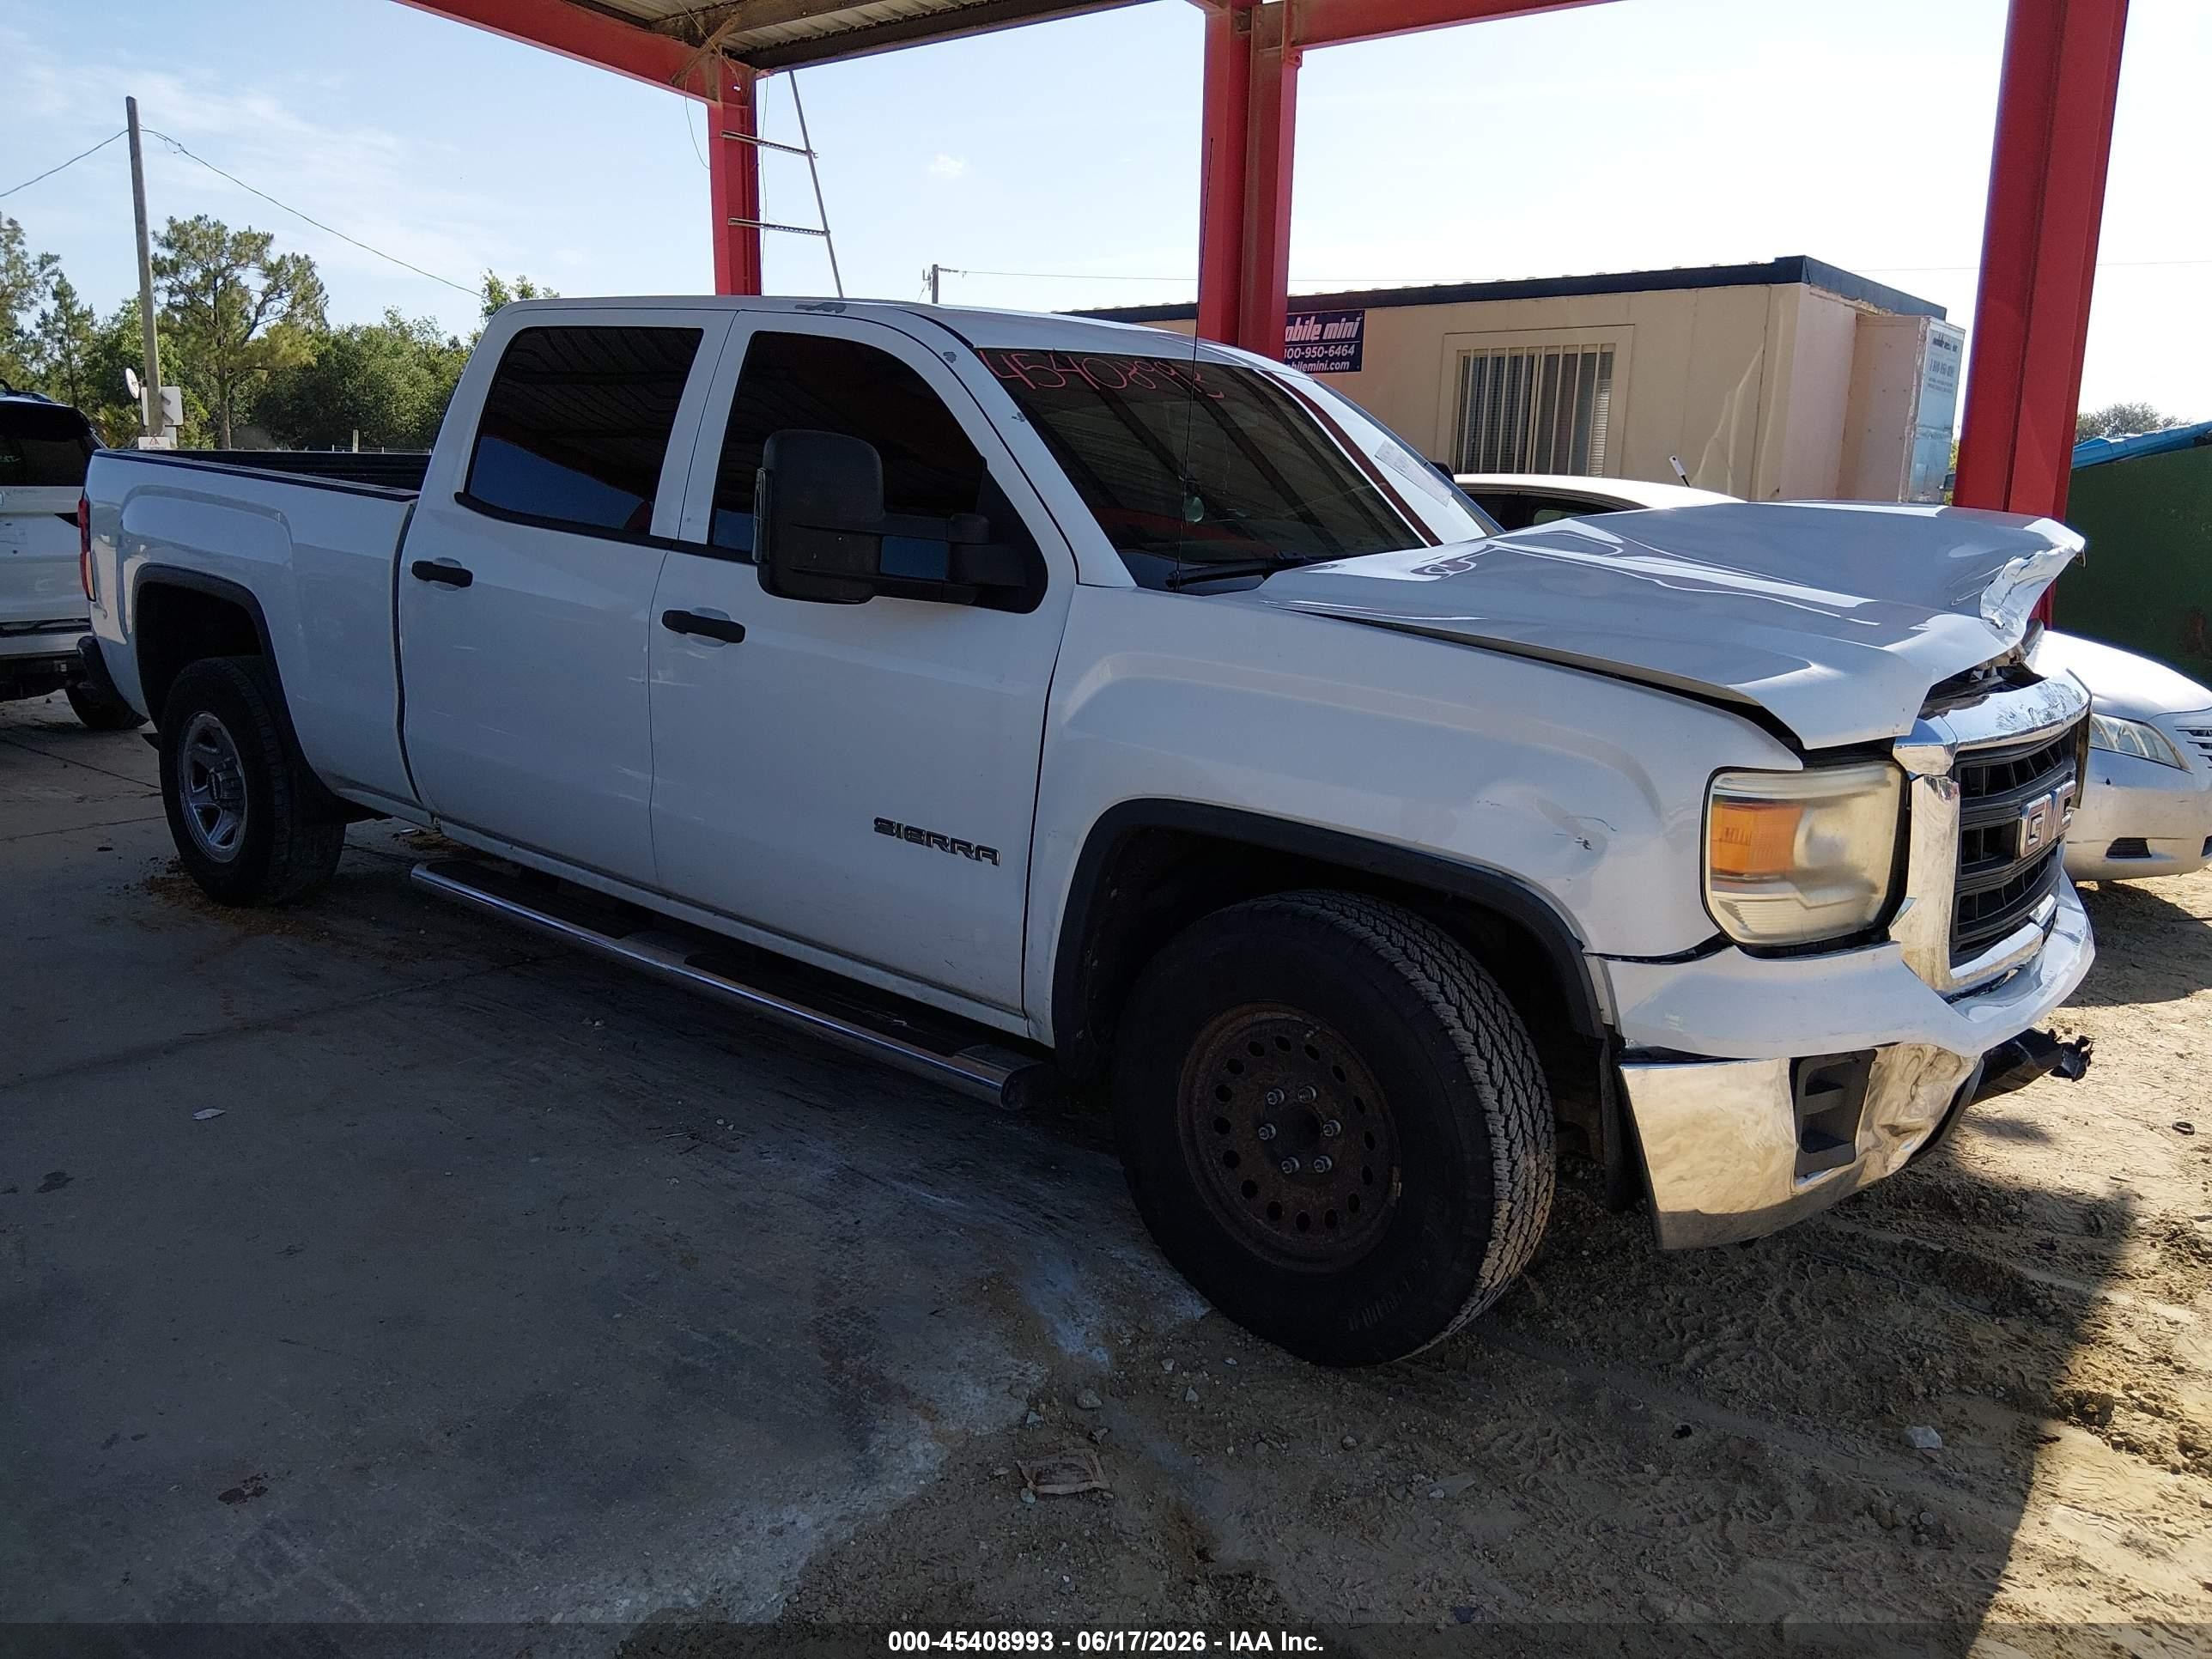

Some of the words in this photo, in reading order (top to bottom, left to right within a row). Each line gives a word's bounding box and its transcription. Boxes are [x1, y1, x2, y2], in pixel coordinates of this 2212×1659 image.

[1285, 316, 1322, 343] obile
[1322, 317, 1362, 340] mini
[1285, 344, 1355, 359] 00-950-6464
[873, 817, 1000, 866] SIERRA
